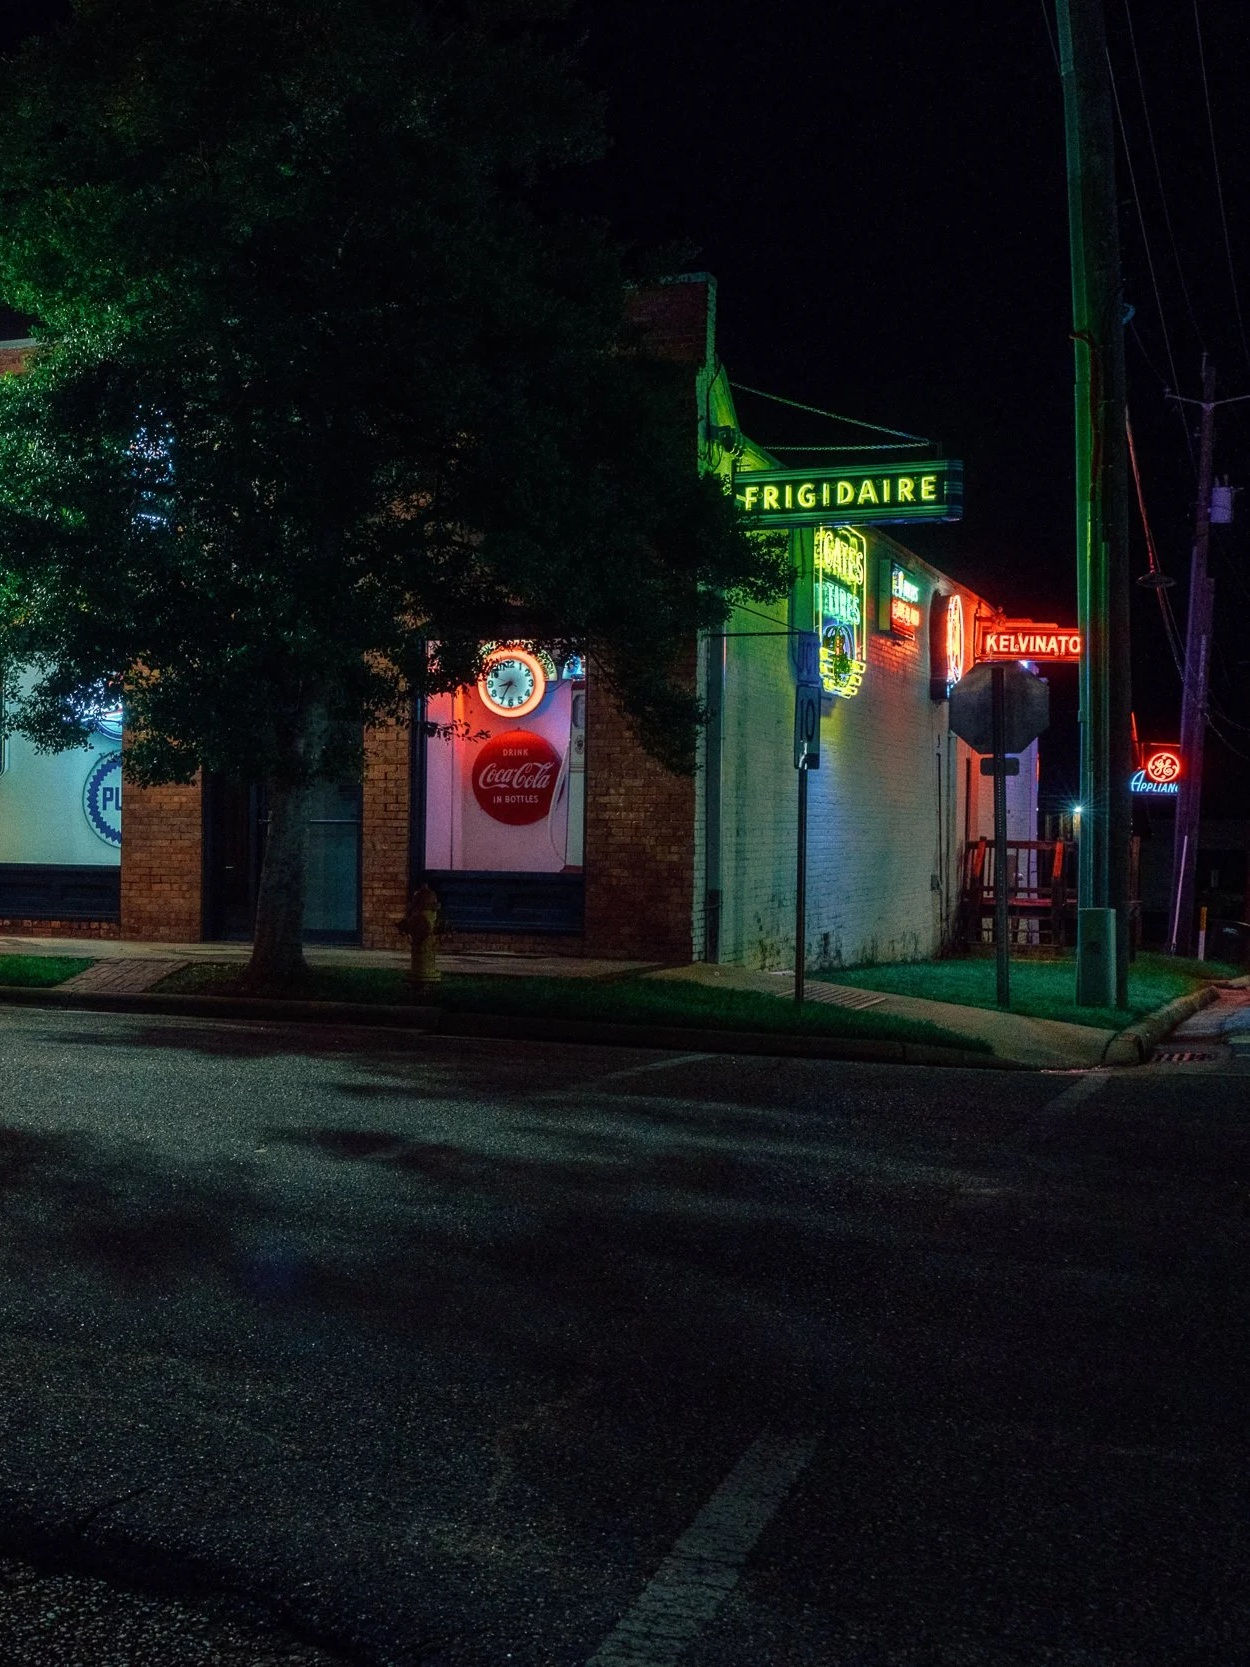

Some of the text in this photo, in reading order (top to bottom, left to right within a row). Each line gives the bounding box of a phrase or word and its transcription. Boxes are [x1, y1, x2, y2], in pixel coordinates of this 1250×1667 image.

[744, 475, 937, 511] FRIGIDAIRE
[823, 531, 864, 585] GATES
[826, 583, 861, 626] TIRES
[986, 634, 1081, 654] KELVINATO
[502, 748, 529, 757] DRINK
[478, 761, 556, 789] Coca-Cola
[493, 794, 539, 804] IN BOTTLES
